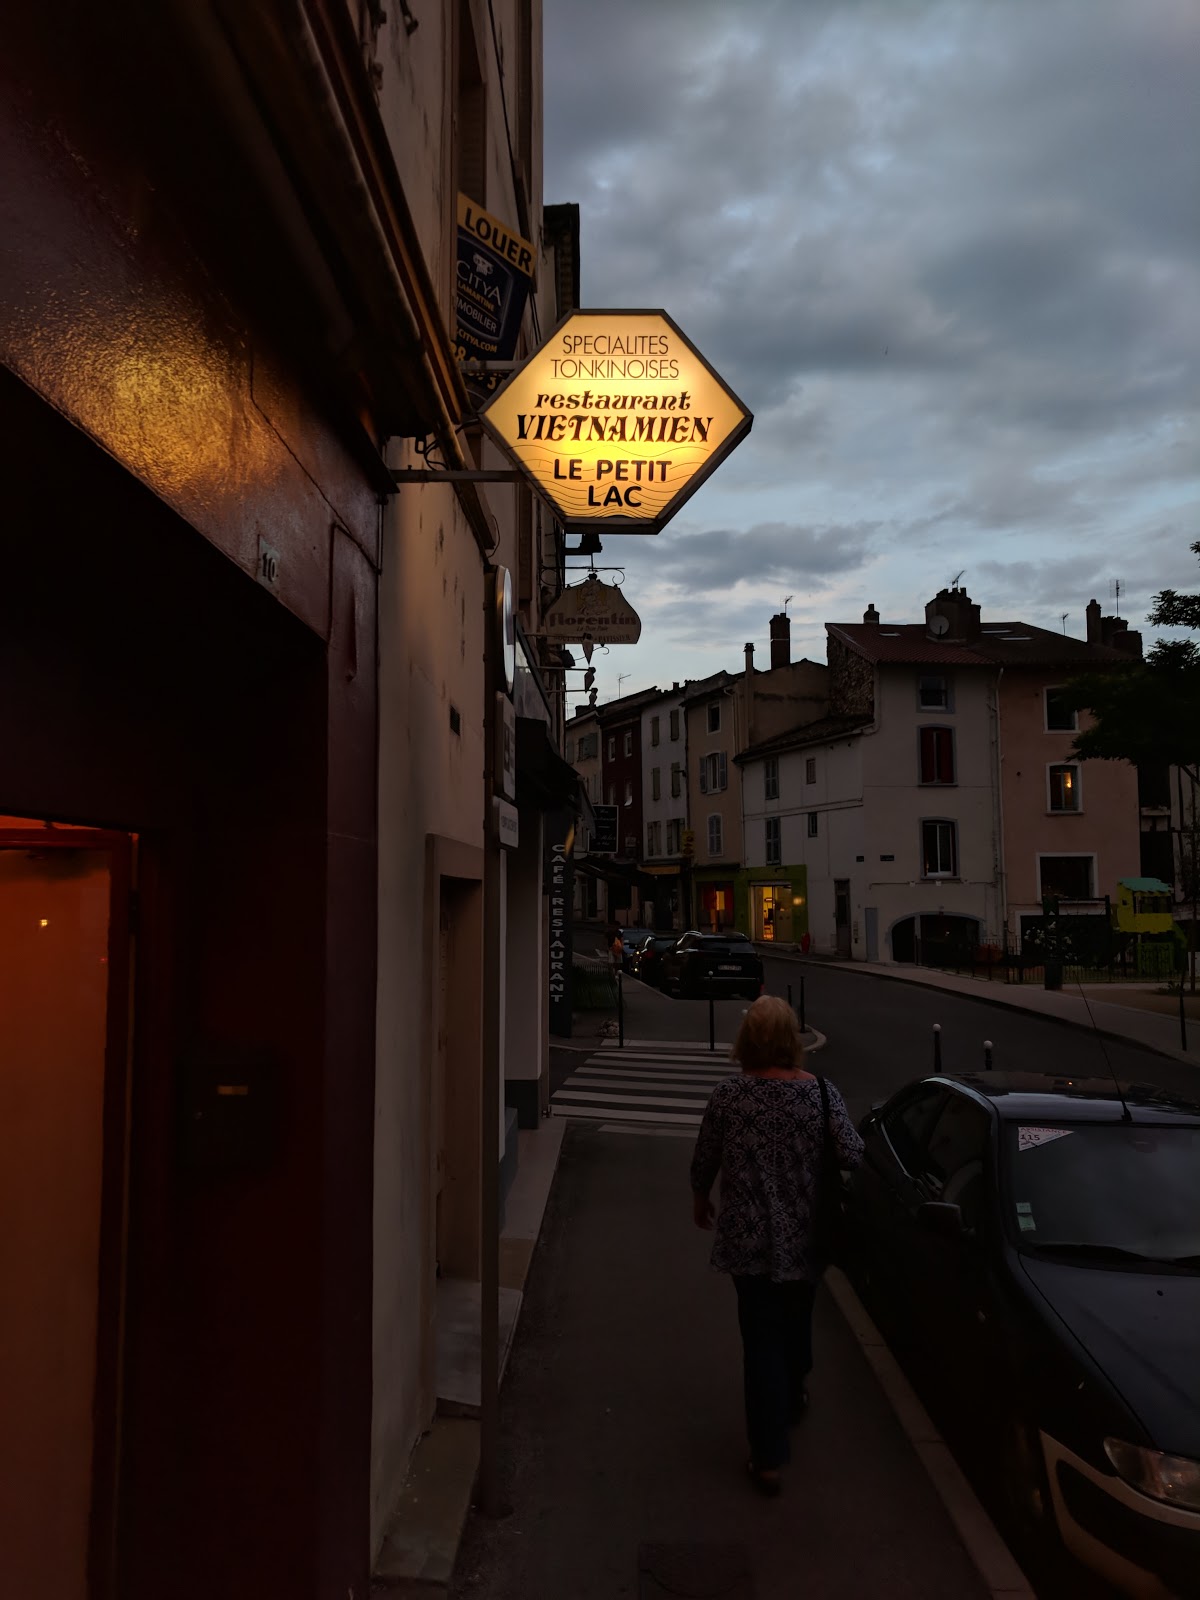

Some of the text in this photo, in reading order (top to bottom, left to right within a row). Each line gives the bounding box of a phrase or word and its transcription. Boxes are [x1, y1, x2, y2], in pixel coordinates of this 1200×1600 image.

[465, 206, 533, 273] LOUER
[457, 260, 502, 306] CITYA
[563, 335, 669, 355] SPECIALITES
[551, 359, 680, 379] TONKINOISES
[535, 390, 691, 410] restaurant
[517, 414, 714, 443] VIETNAMIEN
[554, 458, 672, 482] LE PETIT
[588, 485, 642, 507] LAC
[262, 552, 276, 582] 10
